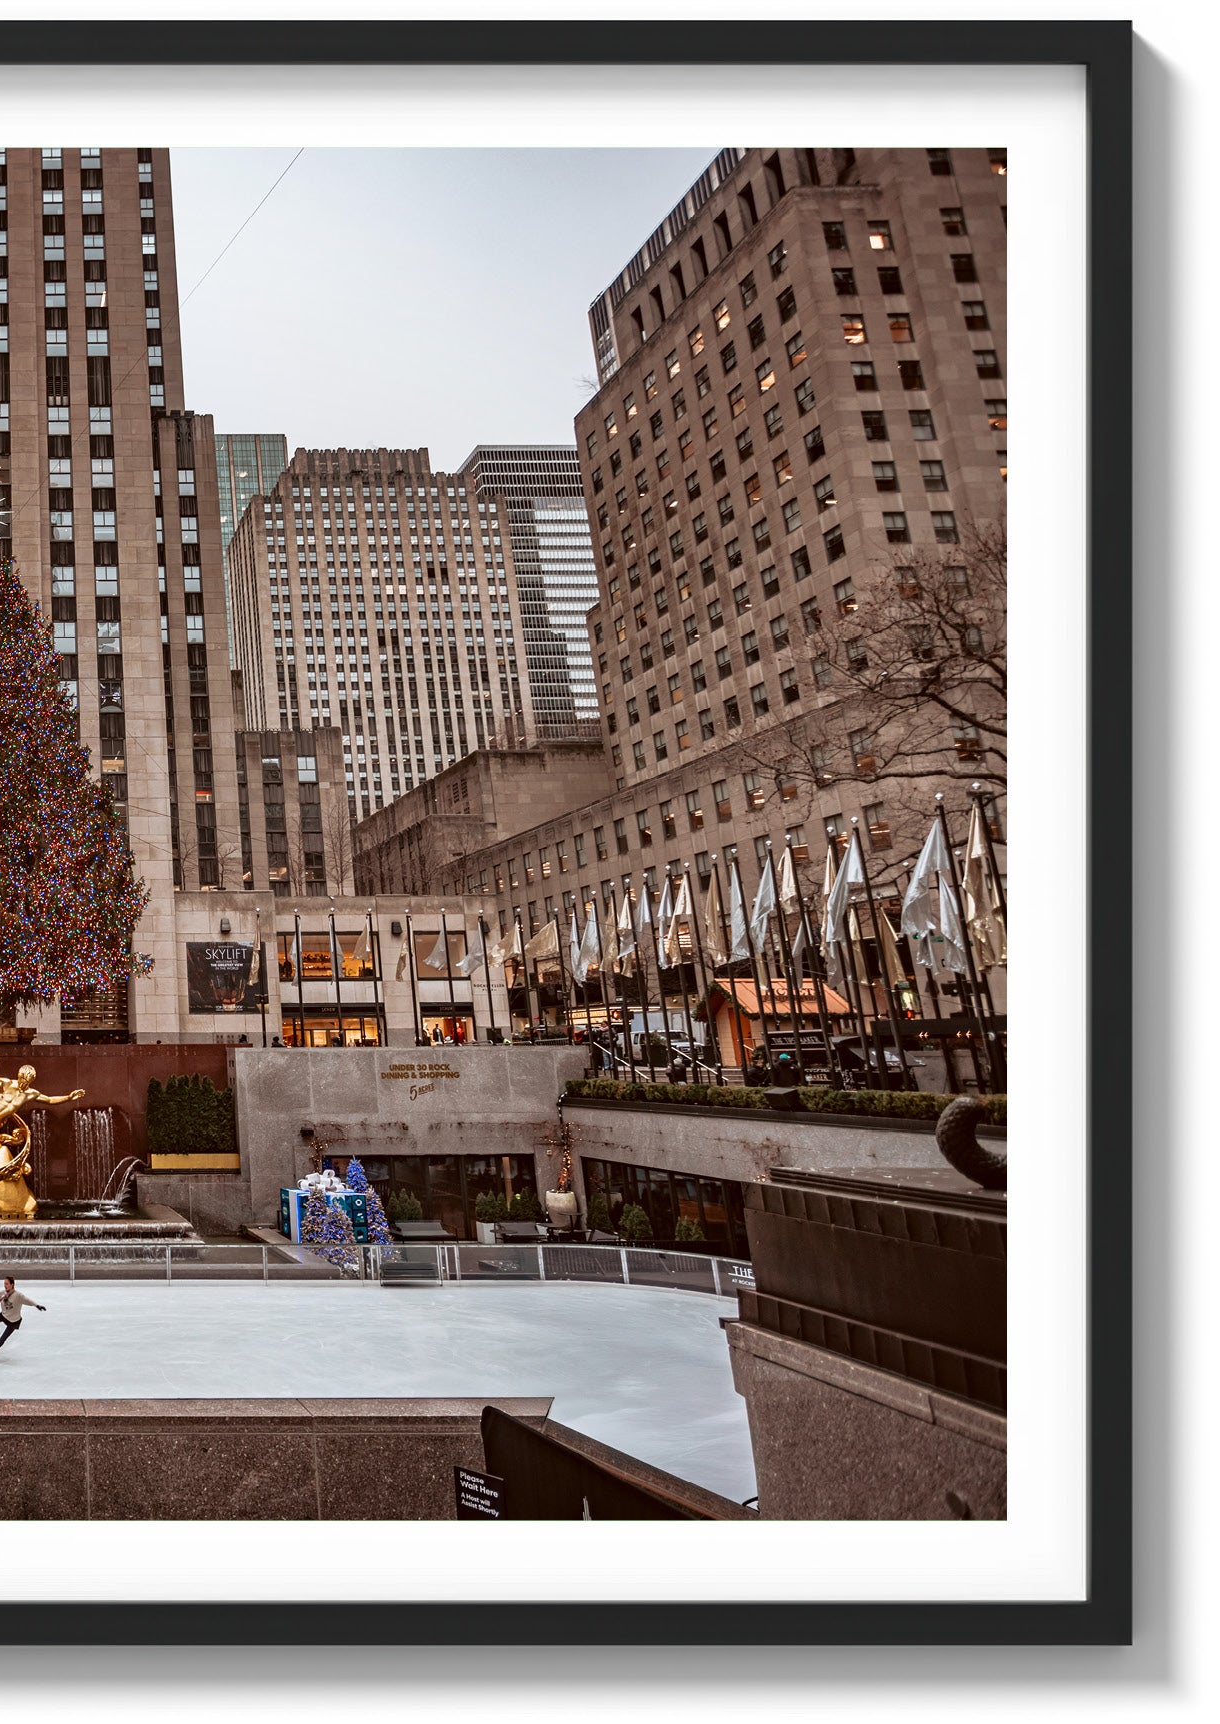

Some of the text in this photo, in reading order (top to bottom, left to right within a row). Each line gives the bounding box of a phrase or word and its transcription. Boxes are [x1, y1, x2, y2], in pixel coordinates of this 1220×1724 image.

[205, 948, 247, 960] SKYLIFT
[428, 1063, 450, 1071] ROCK
[410, 1085, 417, 1101] 5
[732, 1265, 753, 1278] THE
[460, 1471, 484, 1485] Please
[460, 1479, 499, 1498] Wait Here
[466, 1493, 479, 1502] Host
[461, 1499, 499, 1517] Assist Shortly
